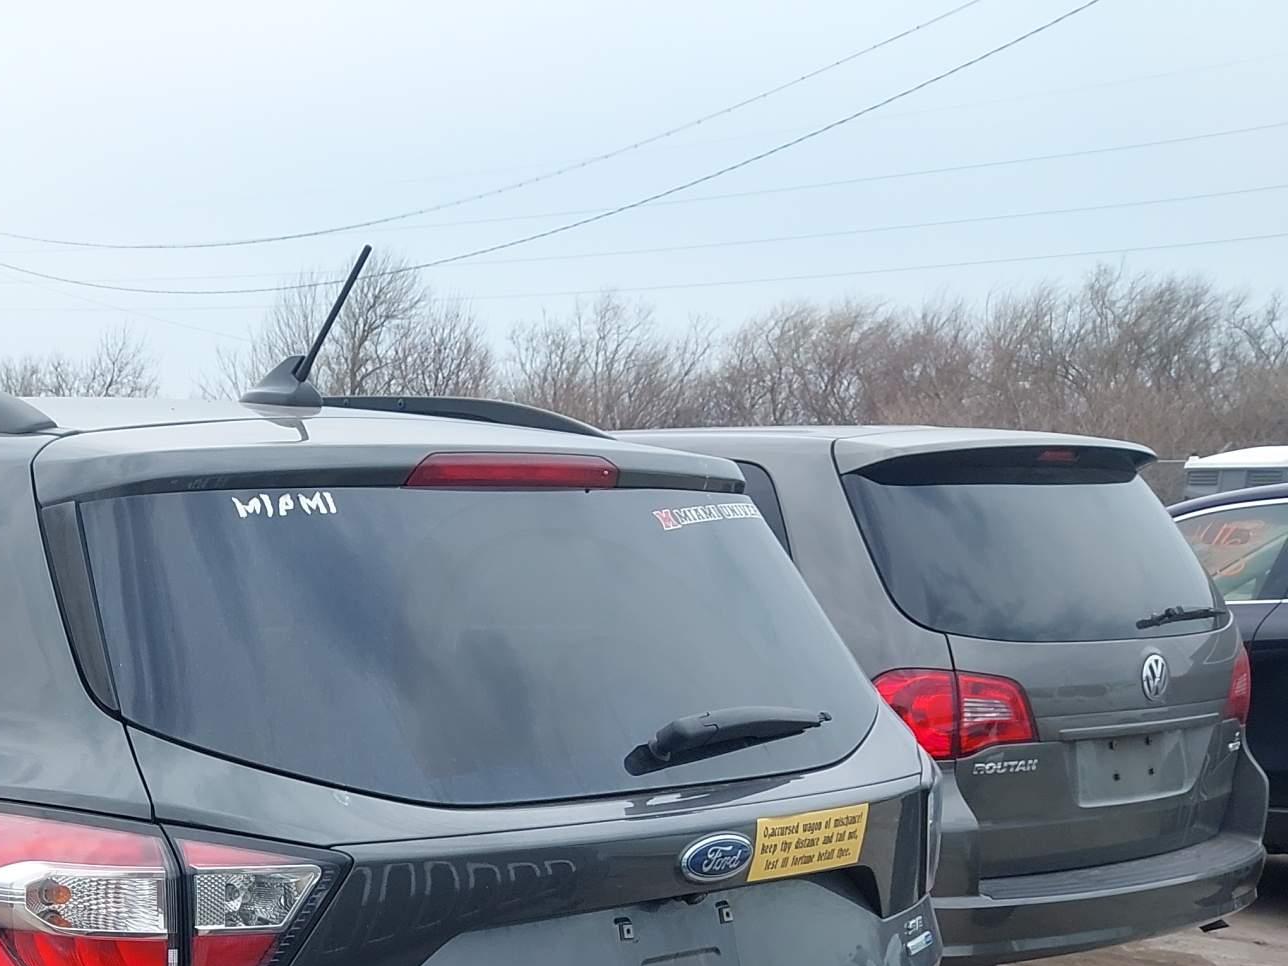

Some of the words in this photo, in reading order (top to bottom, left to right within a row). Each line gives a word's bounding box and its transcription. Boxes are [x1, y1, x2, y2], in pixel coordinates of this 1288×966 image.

[674, 504, 723, 525] MIAMI
[972, 759, 1039, 775] ROUTAN
[824, 817, 832, 829] of
[794, 836, 820, 850] distance
[822, 832, 835, 845] and
[702, 845, 741, 873] Ford
